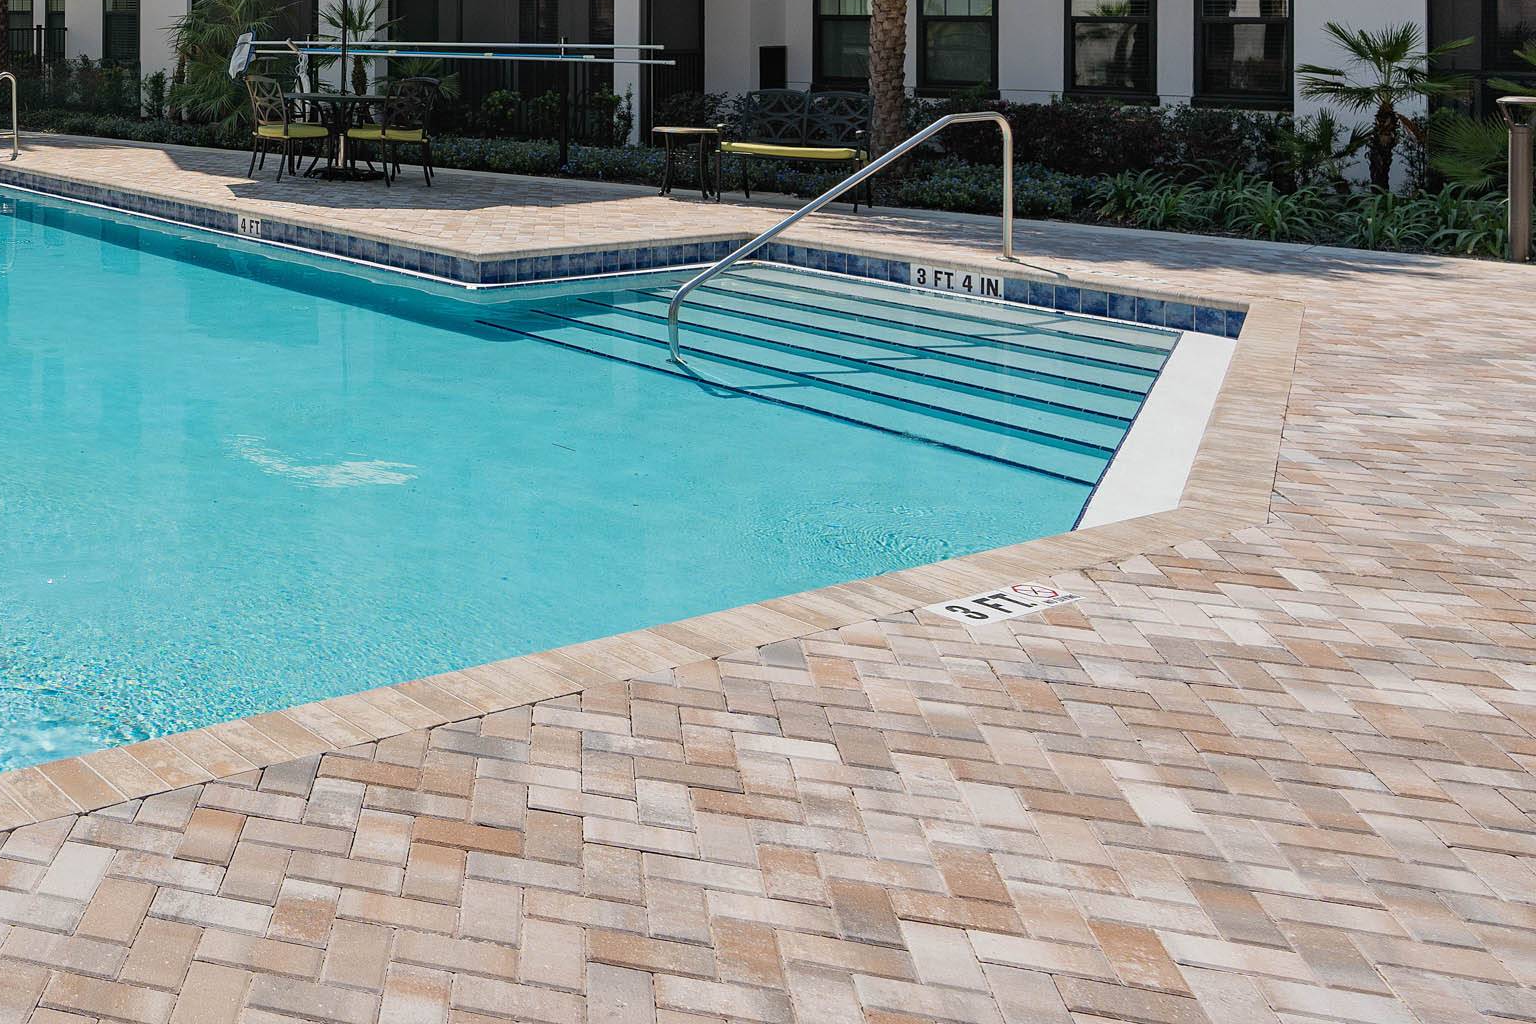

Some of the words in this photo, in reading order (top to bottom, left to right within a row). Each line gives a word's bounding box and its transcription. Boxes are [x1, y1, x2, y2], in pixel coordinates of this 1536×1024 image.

[240, 218, 246, 232] 4
[917, 268, 927, 285] 3
[934, 269, 954, 290] FT.
[962, 274, 973, 293] 4
[980, 277, 1002, 298] IN.
[945, 605, 990, 620] 3
[971, 592, 1038, 614] FT.
